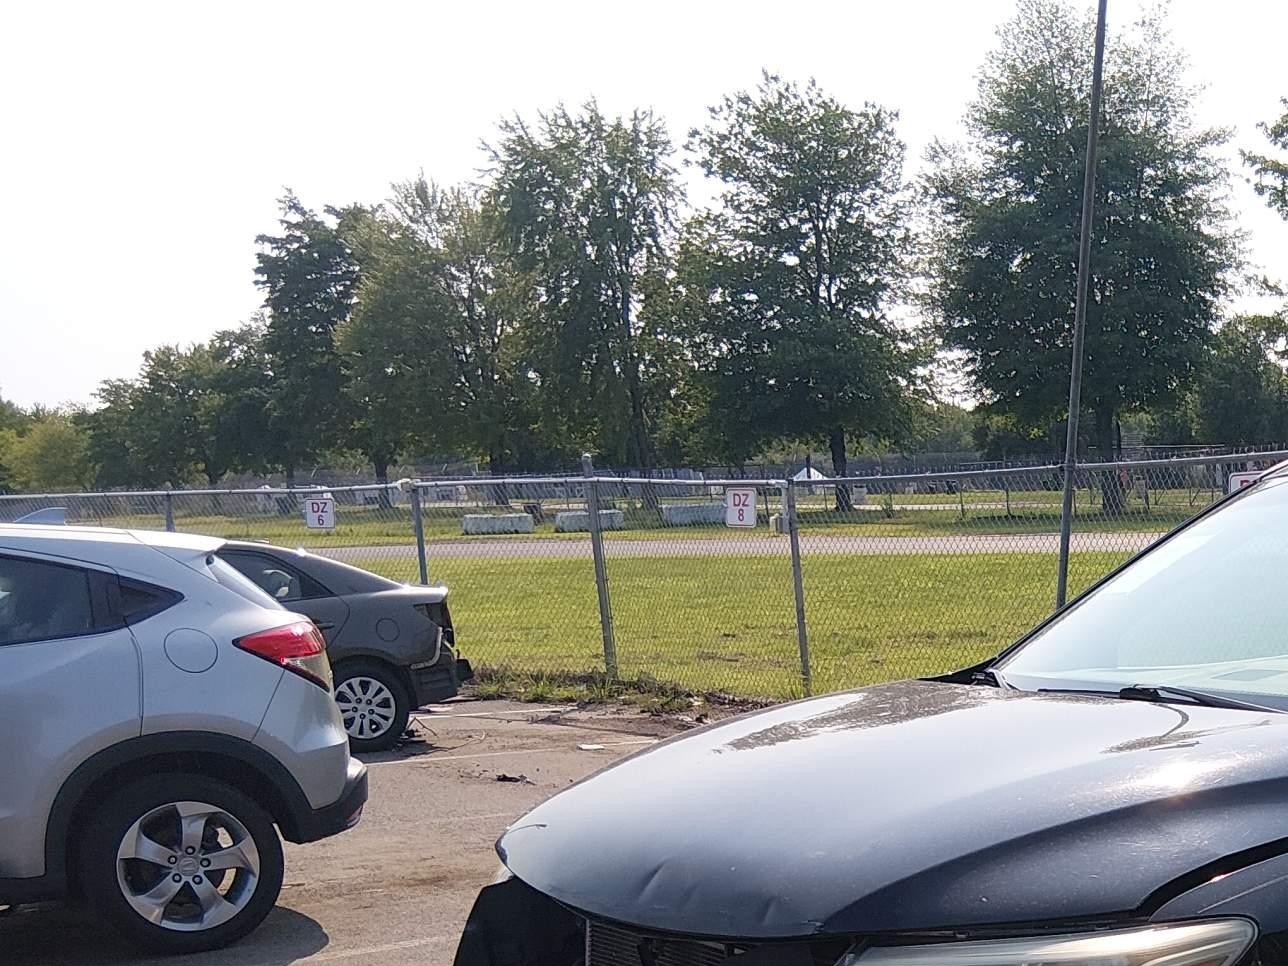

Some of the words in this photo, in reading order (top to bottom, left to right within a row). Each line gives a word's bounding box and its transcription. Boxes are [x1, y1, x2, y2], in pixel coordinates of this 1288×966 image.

[733, 493, 750, 507] DZ
[311, 502, 328, 514] DZ
[317, 514, 325, 526] 6
[737, 508, 745, 522] 8
